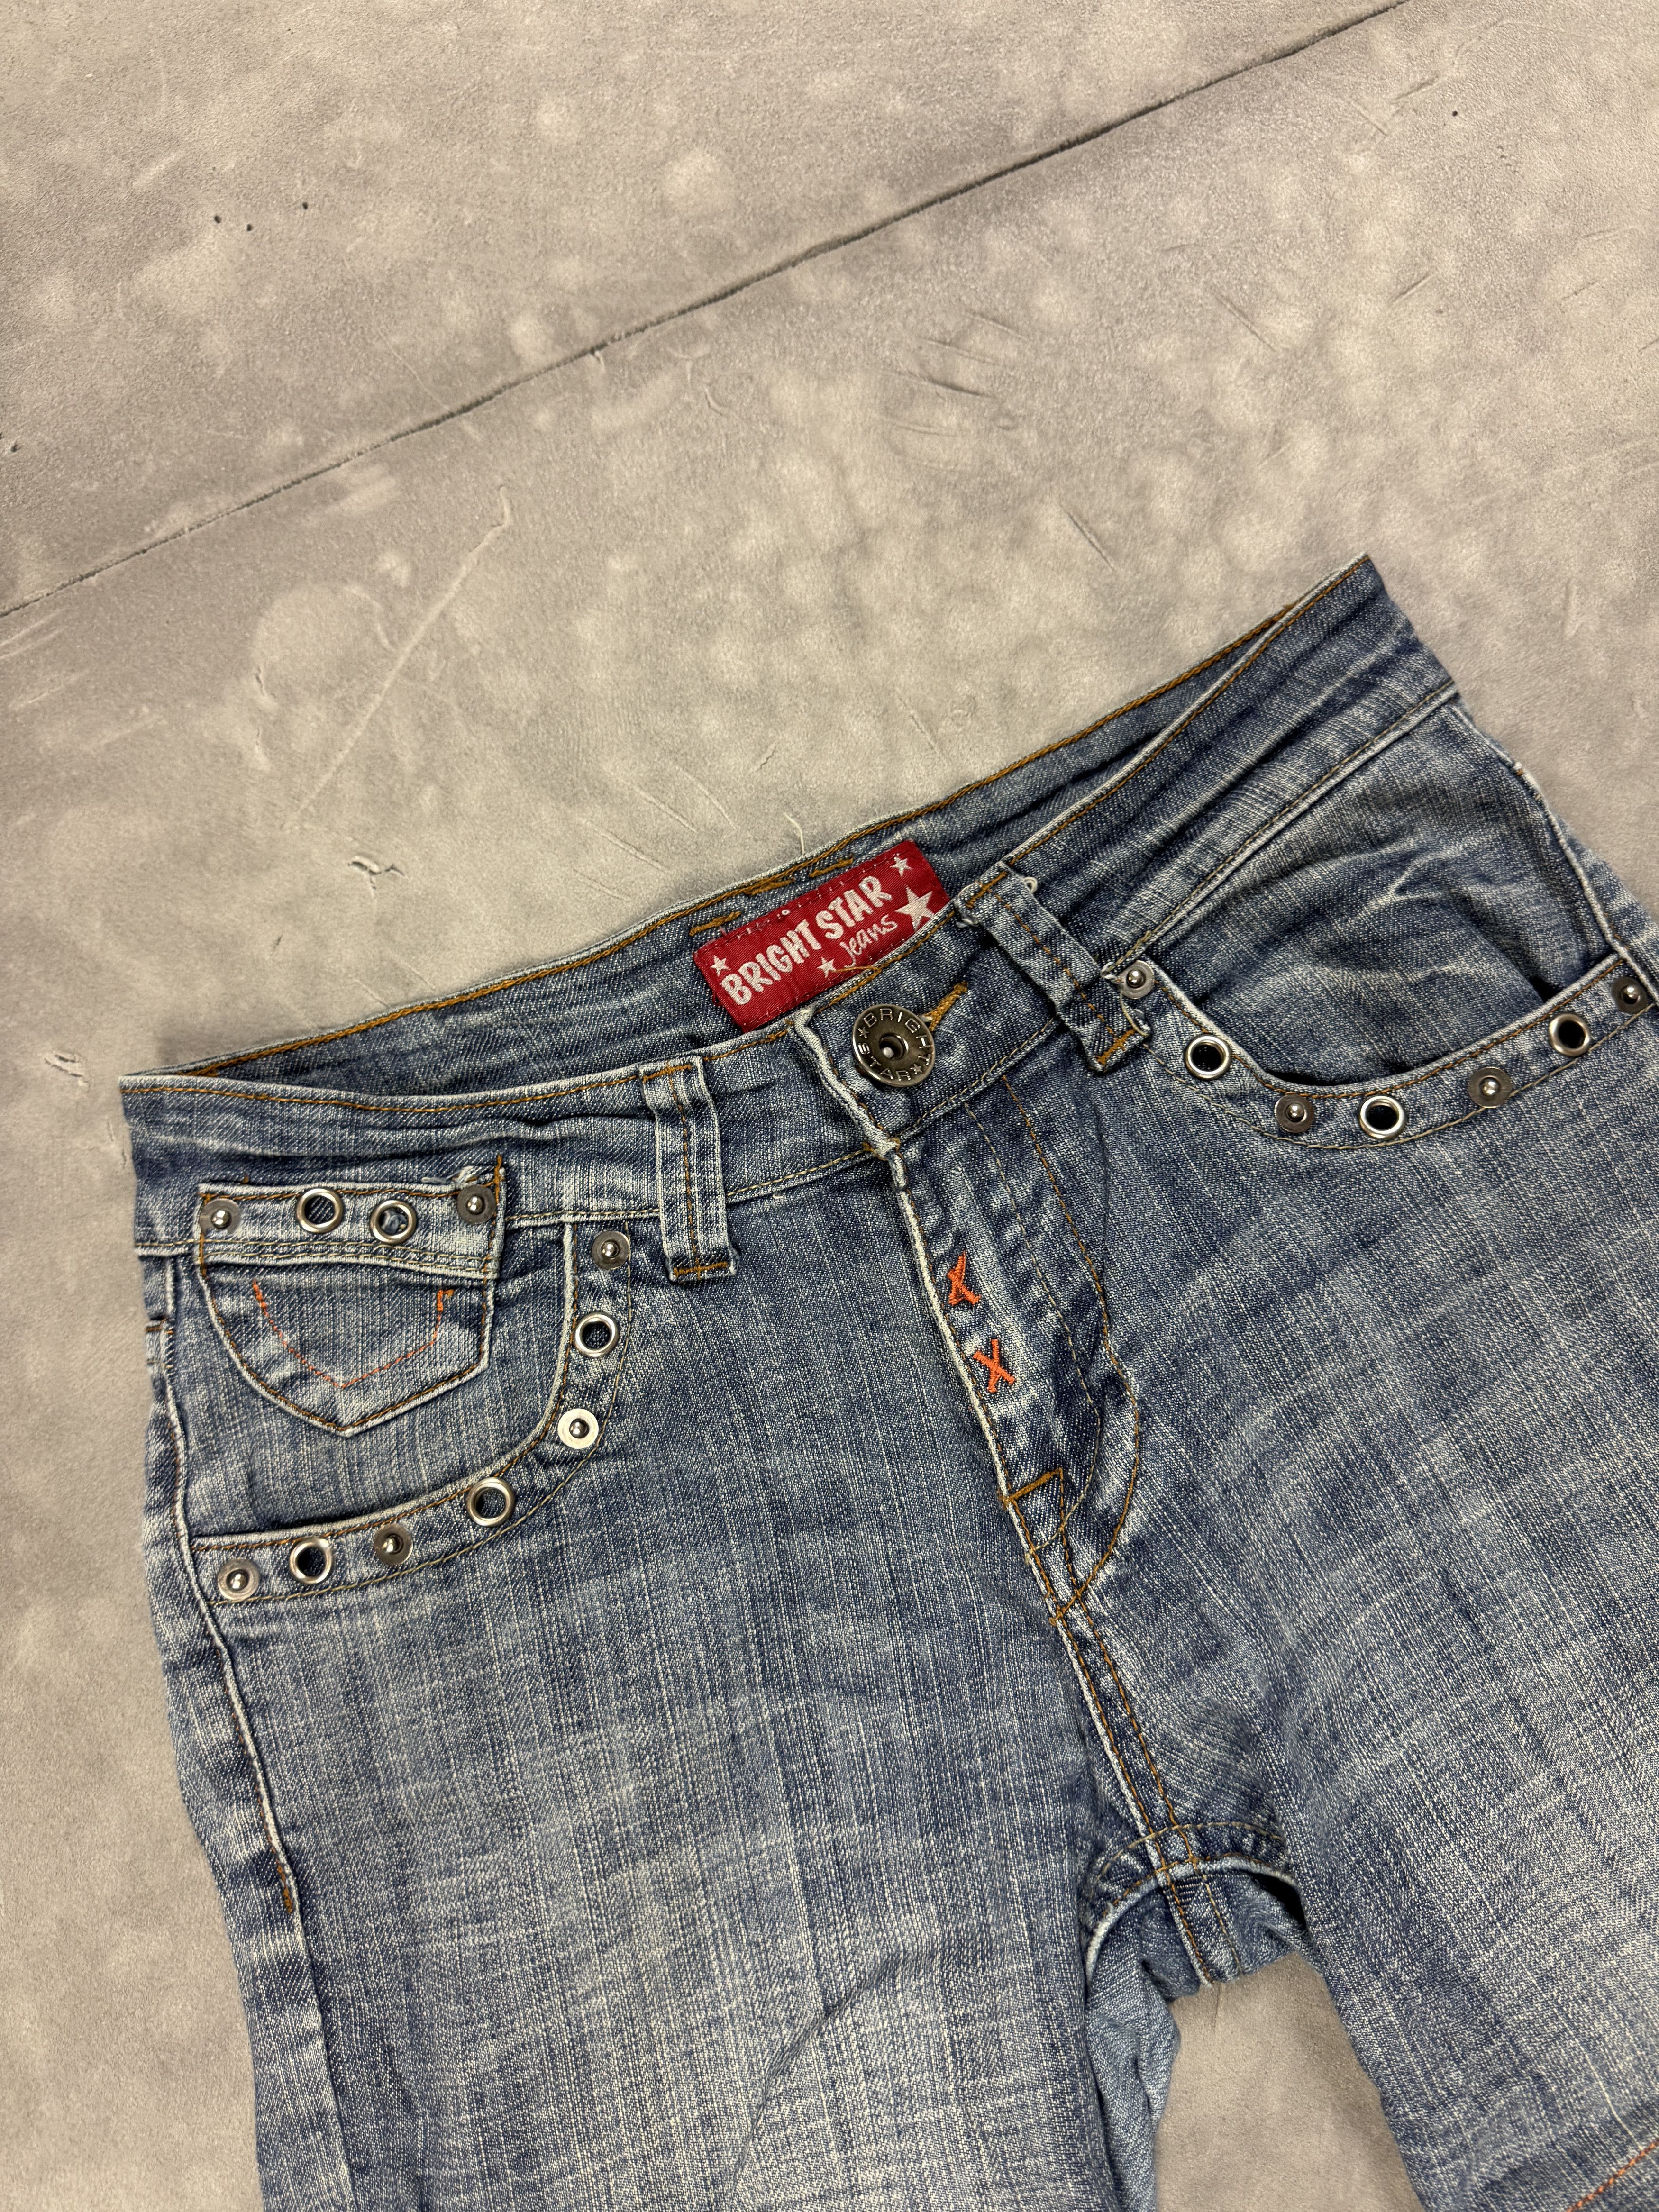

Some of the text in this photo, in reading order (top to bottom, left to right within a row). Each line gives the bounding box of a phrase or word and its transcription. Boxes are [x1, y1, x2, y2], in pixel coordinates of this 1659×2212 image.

[721, 875, 893, 1005] BRIGHT STAR
[858, 1008, 933, 1081] BRIGHT STAR
